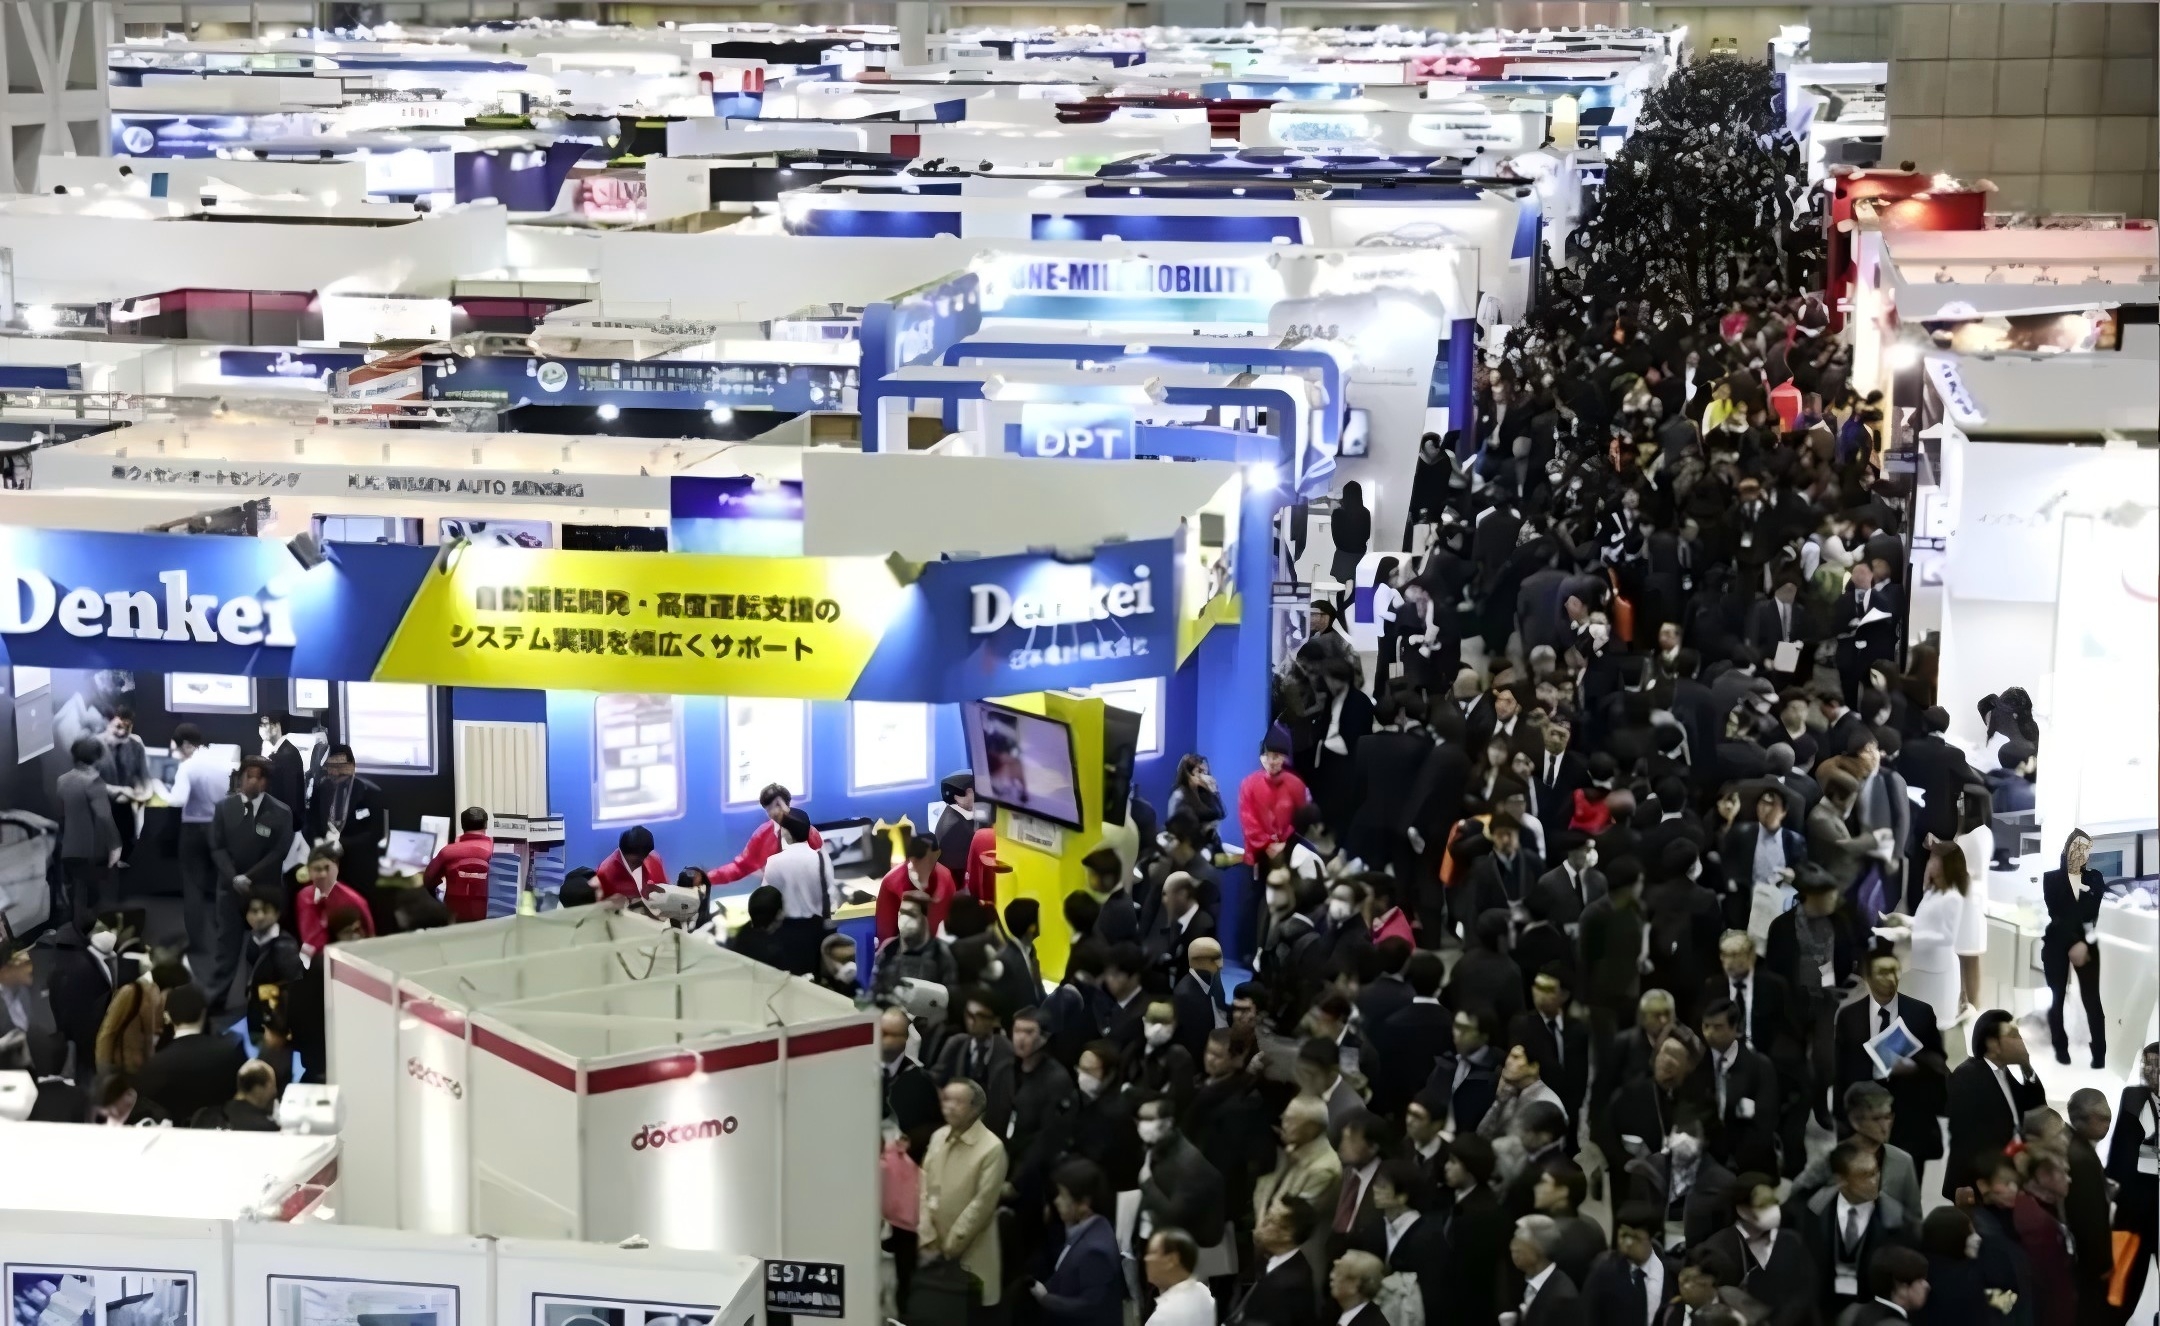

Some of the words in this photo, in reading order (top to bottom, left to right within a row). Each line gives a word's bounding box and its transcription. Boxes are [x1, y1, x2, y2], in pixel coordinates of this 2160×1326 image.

[1012, 262, 1122, 292] ONE-MIL
[1134, 263, 1252, 293] OBILITY
[1036, 427, 1124, 459] DPT
[456, 478, 506, 495] AUTO
[0, 569, 297, 647] Denkei
[969, 564, 1155, 635] Denkei
[631, 1115, 738, 1151] docomo
